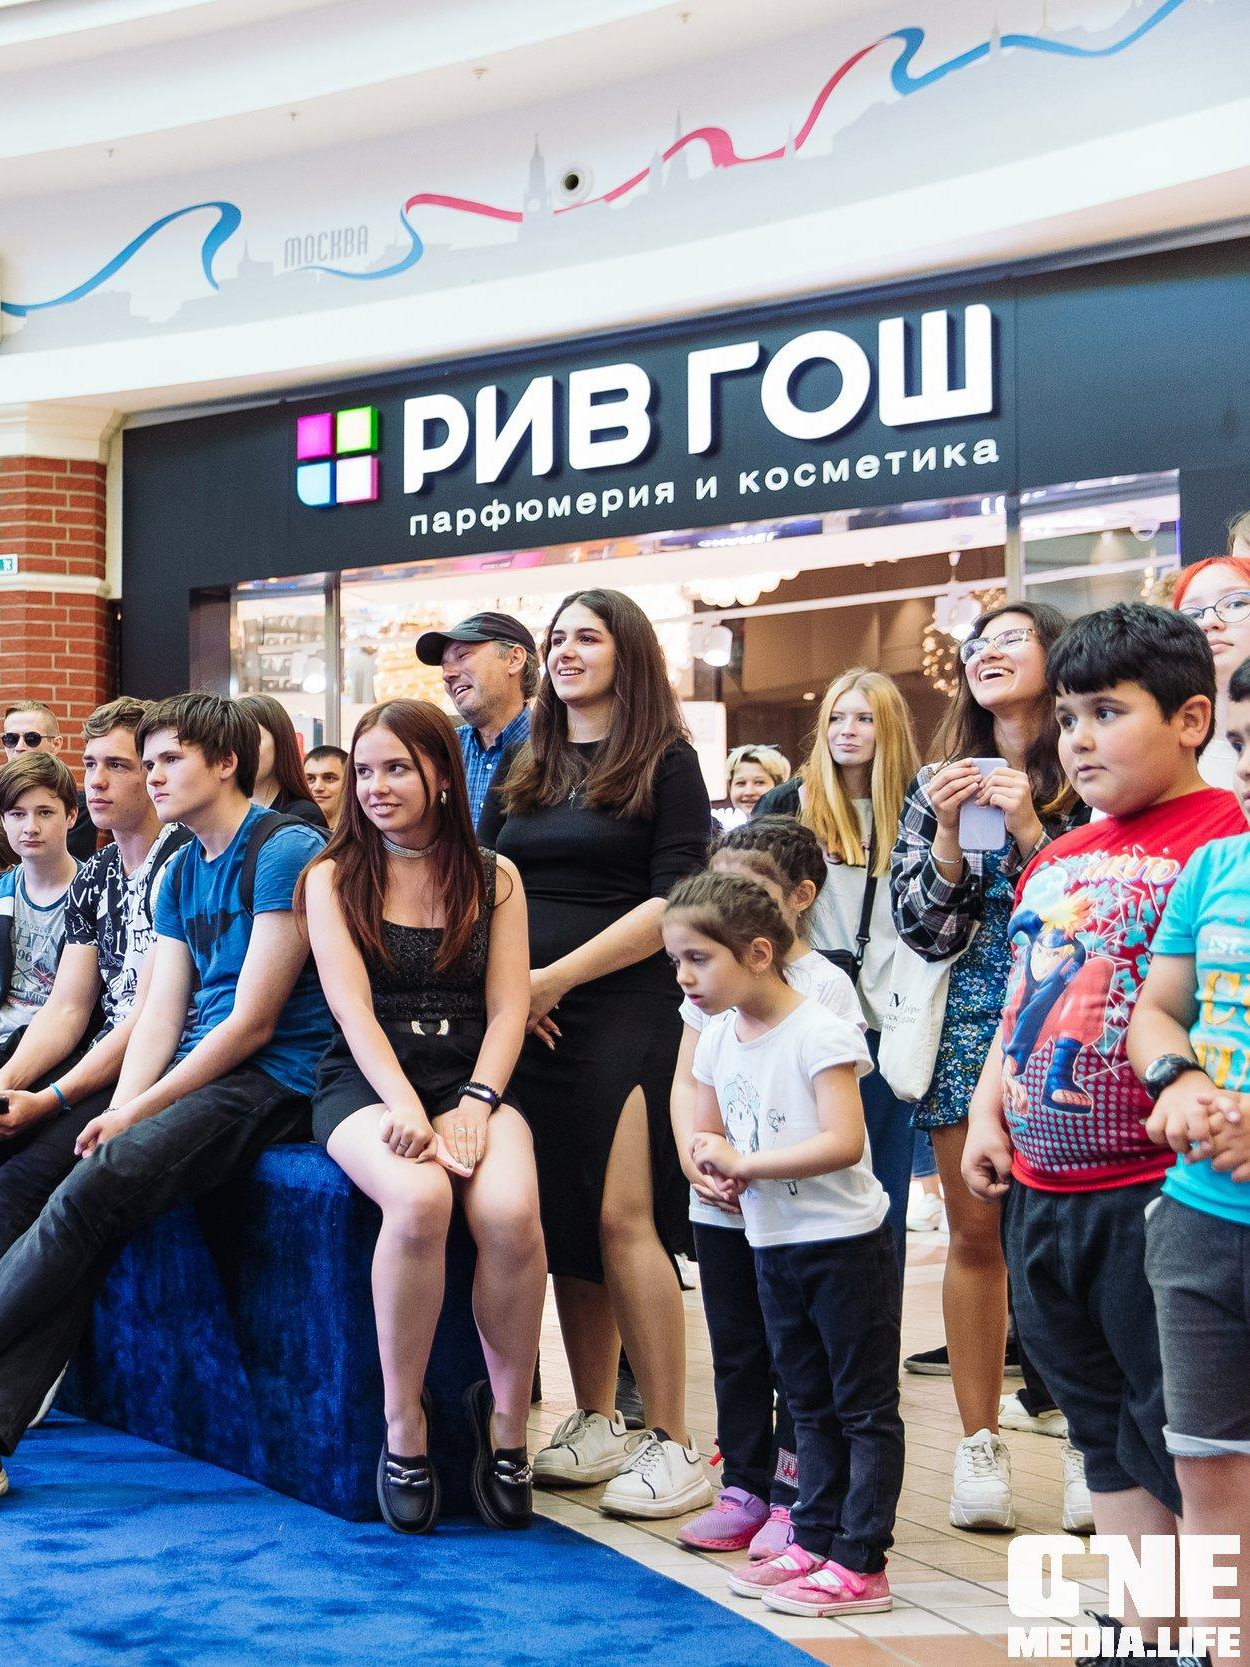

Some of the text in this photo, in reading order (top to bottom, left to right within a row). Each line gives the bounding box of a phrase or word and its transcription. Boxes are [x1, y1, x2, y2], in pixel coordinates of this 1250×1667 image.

[284, 224, 369, 268] МОСКВА
[403, 303, 993, 494] РИВ ГОШ
[409, 437, 1000, 537] парфюмерия и косметика
